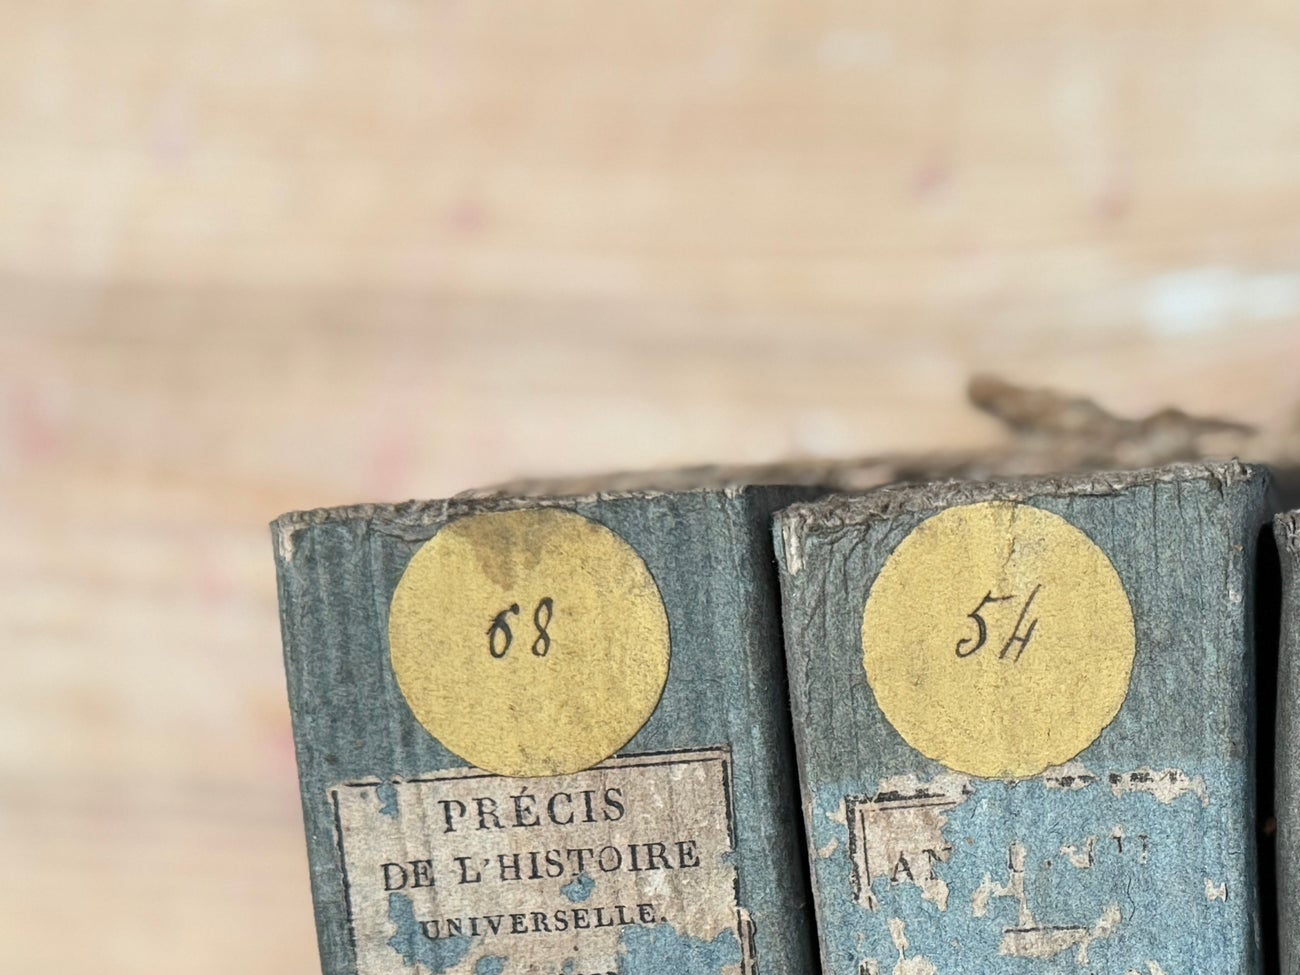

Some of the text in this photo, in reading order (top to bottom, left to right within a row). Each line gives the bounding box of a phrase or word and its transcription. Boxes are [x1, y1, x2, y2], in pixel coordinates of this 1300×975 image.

[485, 596, 554, 659] 68
[955, 583, 1043, 664] 54
[438, 787, 626, 834] PRÉCIS
[381, 840, 702, 891] DE L'HISTOIRE
[419, 904, 666, 939] UNIVERSELLE.
